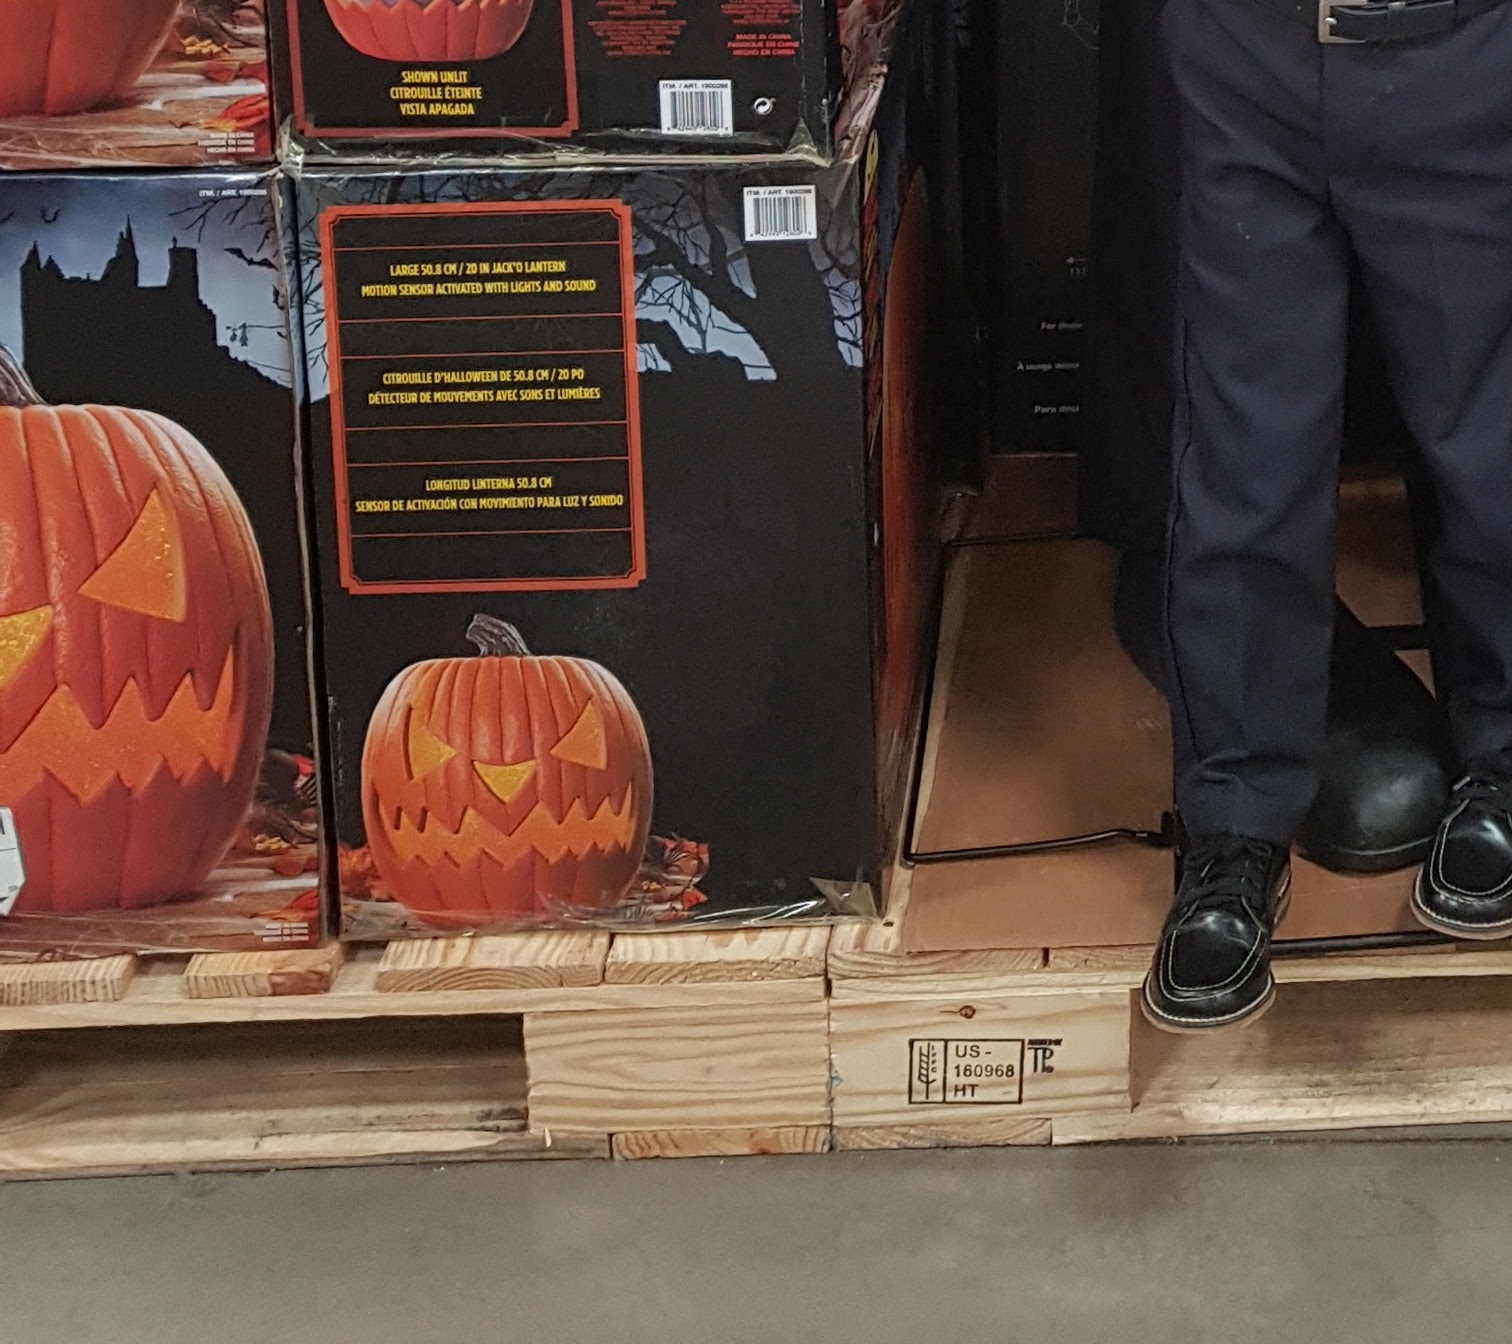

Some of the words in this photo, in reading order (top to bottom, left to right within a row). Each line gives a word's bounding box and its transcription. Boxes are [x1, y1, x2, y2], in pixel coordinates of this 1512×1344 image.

[402, 71, 438, 83] SHOWN
[440, 71, 468, 83] UNLIT
[390, 87, 442, 99] CITROUILLE
[445, 85, 482, 99] ÉTEINTE
[400, 103, 427, 115] VISTA
[429, 103, 475, 115] APAGADA
[355, 499, 390, 512] SENSOR
[392, 499, 404, 511] DE
[459, 498, 477, 510] CON
[480, 497, 535, 510] MOVIMIENTO
[537, 496, 560, 509] PARA
[563, 495, 579, 508] LUZ
[589, 494, 623, 507] SONIDO
[955, 1045, 980, 1058] US
[954, 1064, 1014, 1078] 160968
[954, 1084, 978, 1097] HT
